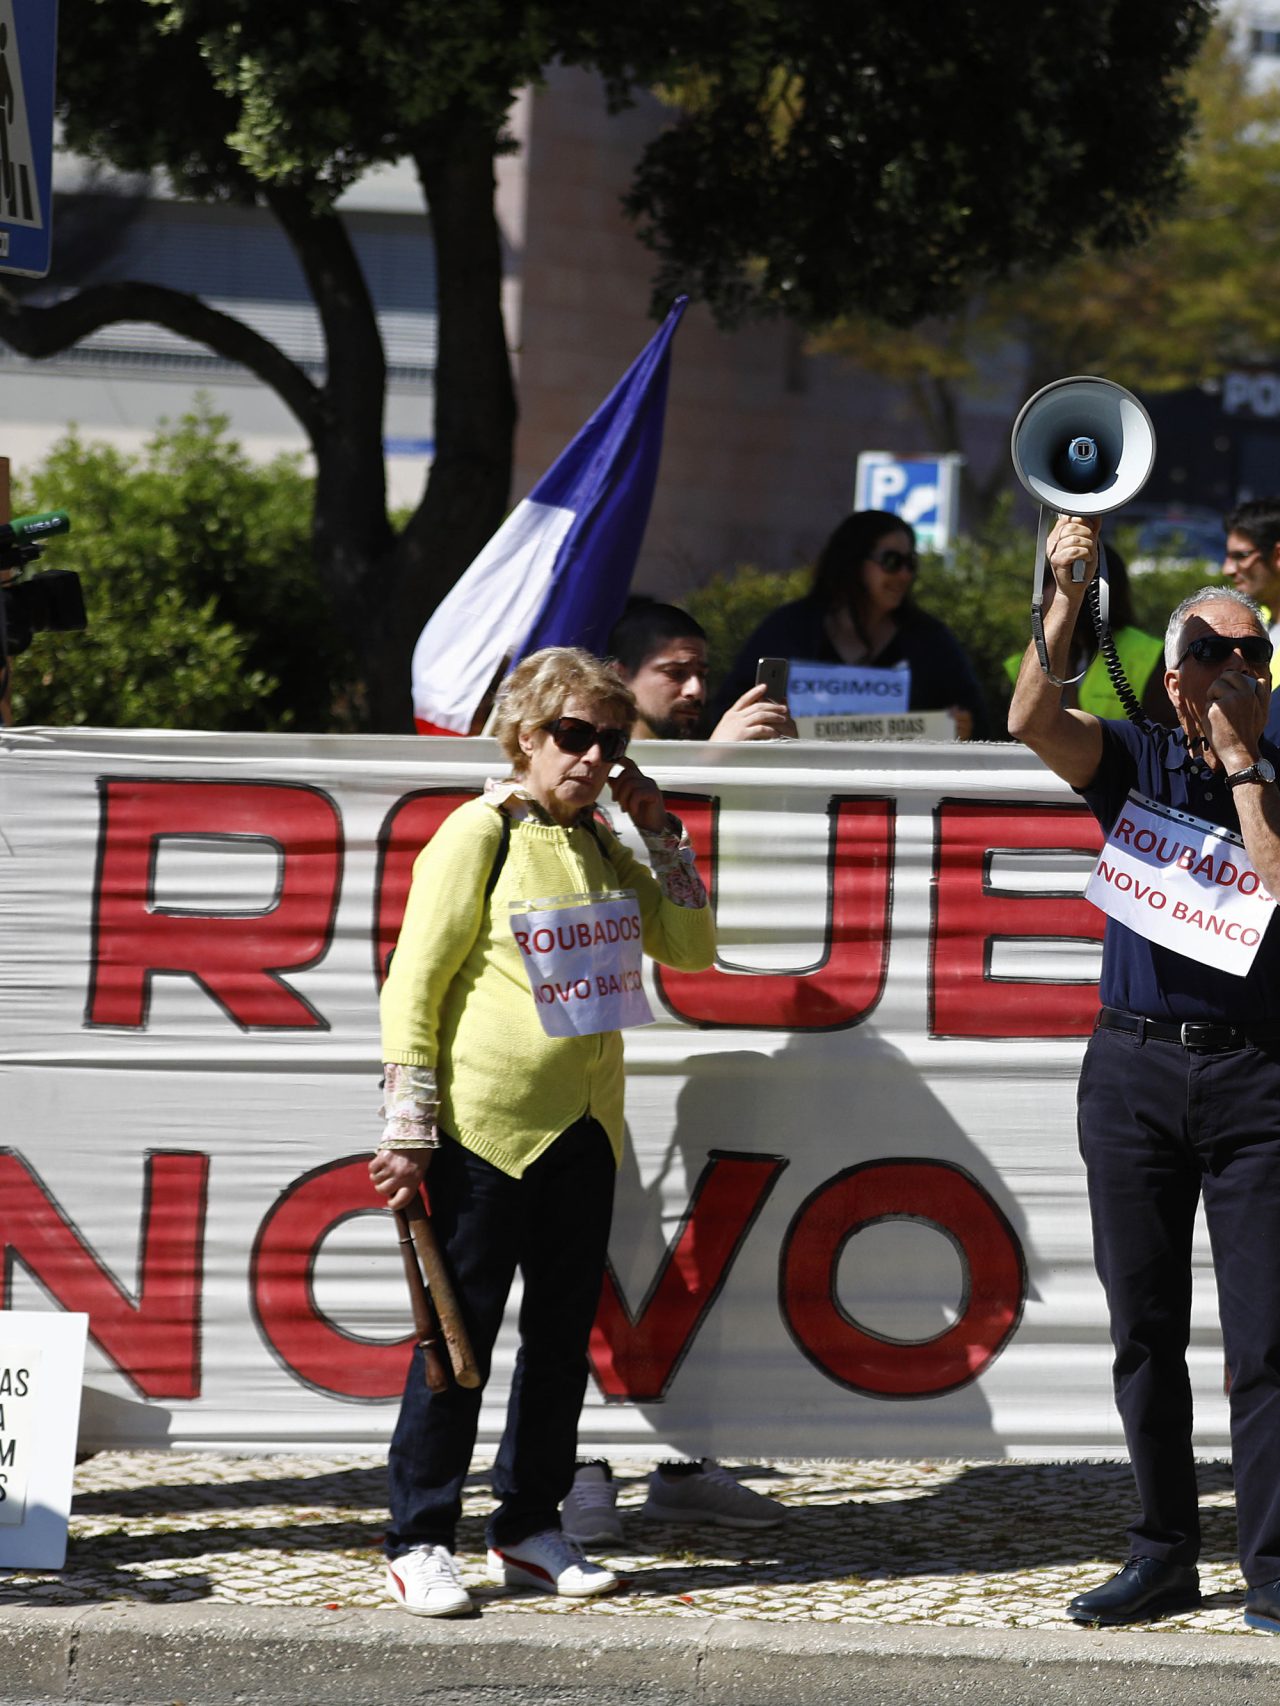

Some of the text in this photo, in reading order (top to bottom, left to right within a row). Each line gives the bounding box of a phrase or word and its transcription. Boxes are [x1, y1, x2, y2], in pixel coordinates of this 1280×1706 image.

[872, 464, 907, 511] P
[790, 678, 904, 698] EXIGIMOS
[814, 717, 926, 738] EXIGIMOS BOAS
[1113, 817, 1274, 902] ROUBADO
[1096, 860, 1261, 947] NOVO BANCO
[513, 915, 641, 956] ROUBADOS
[0, 1145, 1029, 1403] NOVO
